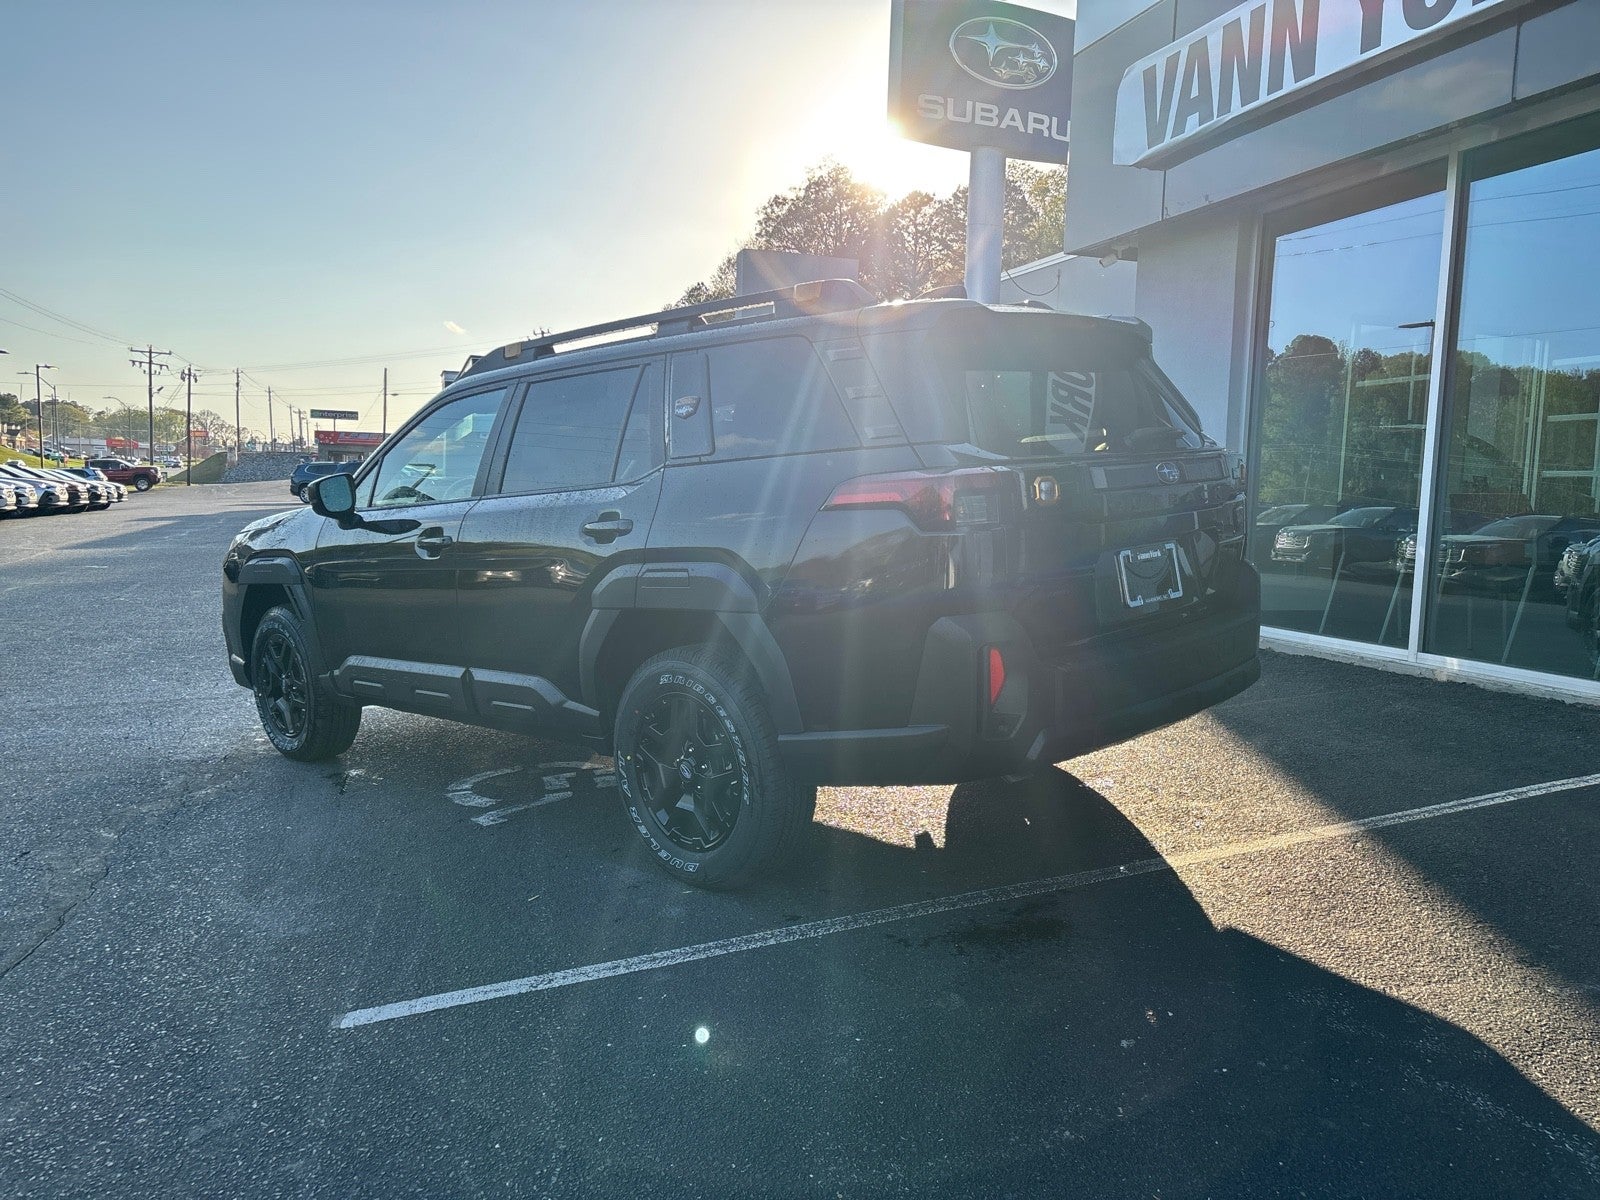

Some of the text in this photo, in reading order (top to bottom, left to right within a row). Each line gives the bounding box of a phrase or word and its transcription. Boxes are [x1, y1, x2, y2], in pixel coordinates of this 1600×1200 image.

[1143, 0, 1320, 150] VANN
[917, 93, 1071, 142] SUBARU
[312, 410, 358, 419] enterprise
[659, 674, 750, 805] BRIDGESTONE
[630, 806, 699, 873] DUELER
